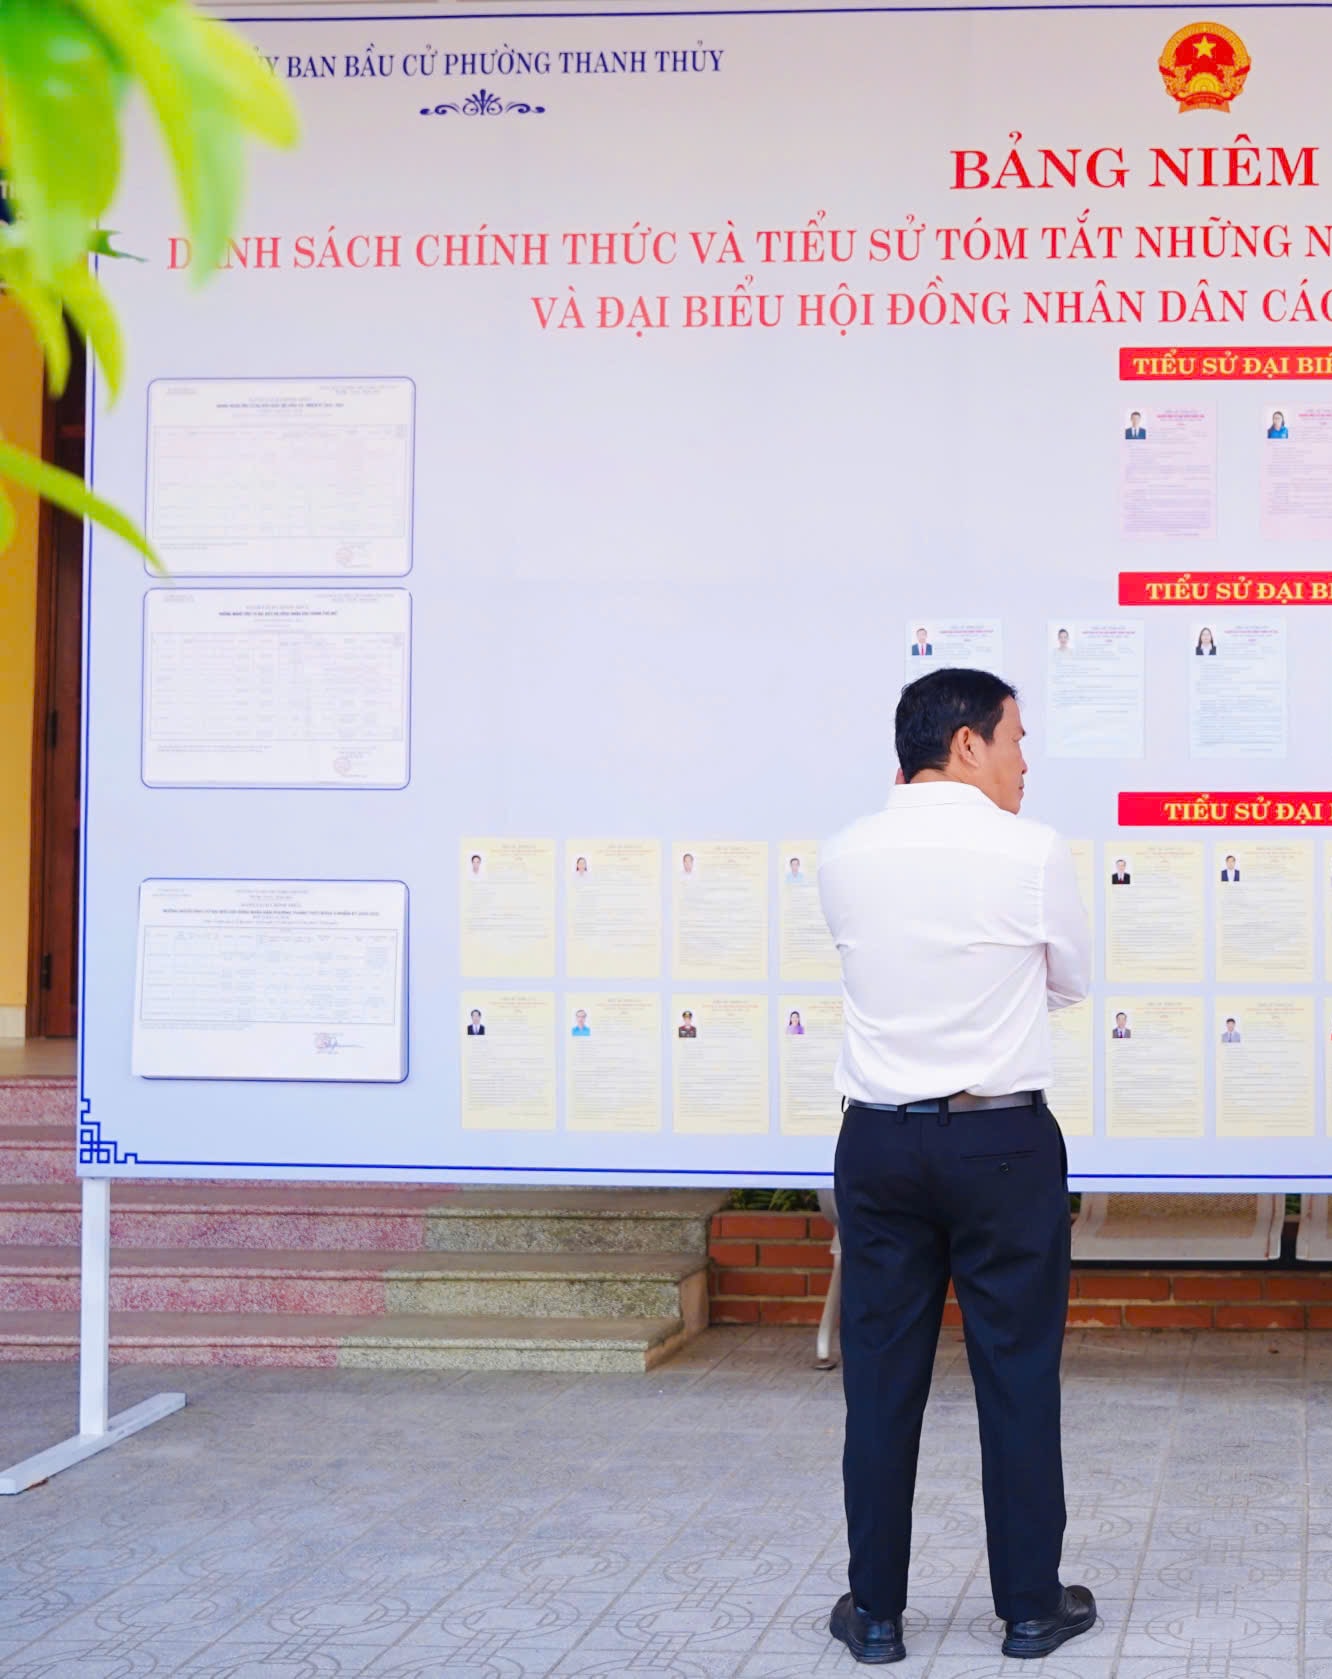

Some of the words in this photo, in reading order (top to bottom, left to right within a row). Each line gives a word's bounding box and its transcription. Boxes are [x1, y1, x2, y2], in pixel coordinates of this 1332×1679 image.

[286, 55, 337, 78] BAN
[343, 42, 395, 78] BẦU
[402, 44, 439, 77] CỬ
[444, 42, 551, 76] PHƯỜNG
[558, 50, 647, 74] THANH
[654, 39, 725, 73] THỦY
[951, 131, 1130, 191] BẢNG
[1148, 132, 1319, 188] NIÊM
[167, 236, 281, 270] DNH
[293, 225, 402, 268] SÁCH
[415, 223, 549, 267] CHÍNH
[562, 221, 677, 265] THỨC
[689, 219, 745, 264] VÀ
[756, 209, 856, 263] TIỂU
[868, 214, 927, 262] SỬ
[935, 216, 1028, 262] TÓM
[1041, 208, 1123, 260] TẮT
[1135, 216, 1291, 259] NHỮNG
[531, 283, 586, 329] VÀ
[597, 295, 670, 338] ĐẠI
[683, 274, 784, 328] BIỂU
[798, 282, 873, 337] HỘI
[887, 275, 1009, 327] ĐỒNG
[1023, 279, 1145, 325] NHÂN
[1158, 278, 1248, 323] DÂN
[1132, 348, 1196, 375] TIỂU
[1202, 351, 1239, 375] SỬ
[1243, 357, 1289, 378] ĐẠI
[1145, 574, 1209, 600] TIỂU
[1215, 575, 1253, 600] SỬ
[1257, 582, 1303, 604] ĐẠI
[1164, 794, 1228, 820] TIỂU
[1234, 795, 1271, 821] SỬ
[1276, 802, 1322, 824] ĐẠI
